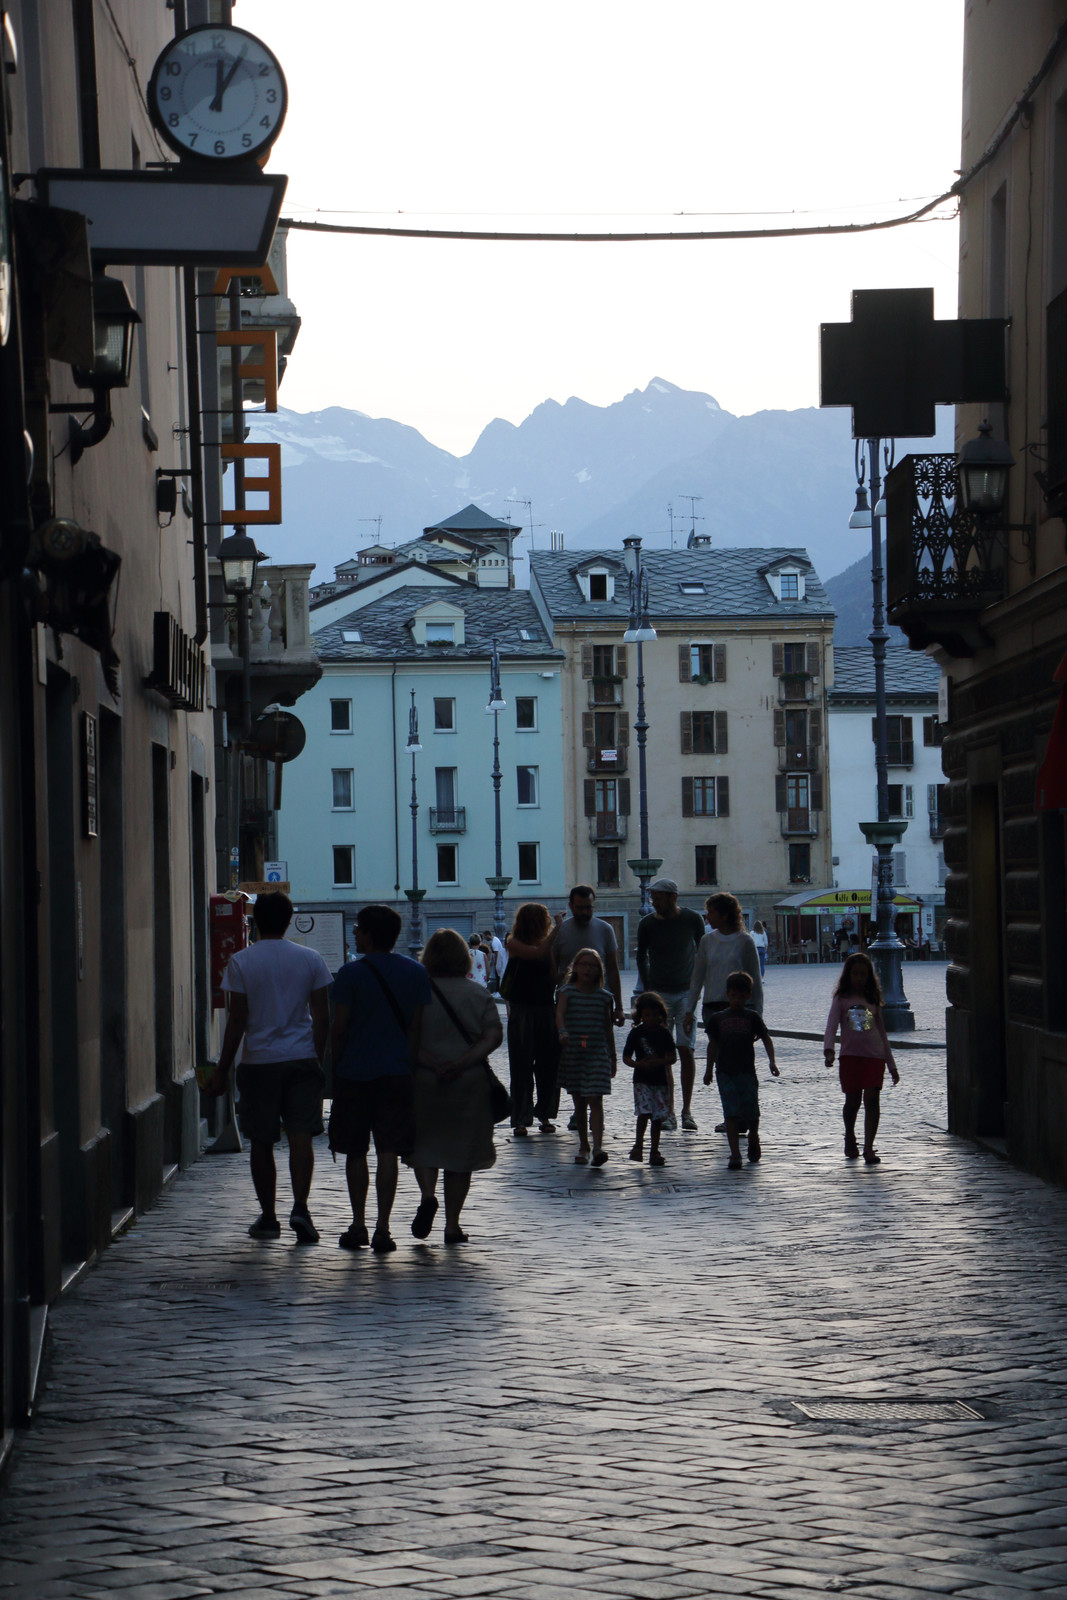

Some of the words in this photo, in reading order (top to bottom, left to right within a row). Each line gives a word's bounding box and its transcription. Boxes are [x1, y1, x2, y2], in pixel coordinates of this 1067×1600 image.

[184, 42, 196, 57] 11
[210, 34, 226, 50] 12
[165, 62, 182, 76] 10
[258, 63, 270, 76] 2
[160, 86, 172, 101] 9
[266, 89, 277, 103] 3
[168, 113, 180, 128] 8
[259, 115, 271, 129] 4
[188, 133, 199, 147] 7
[214, 140, 226, 155] 6
[242, 133, 253, 148] 5
